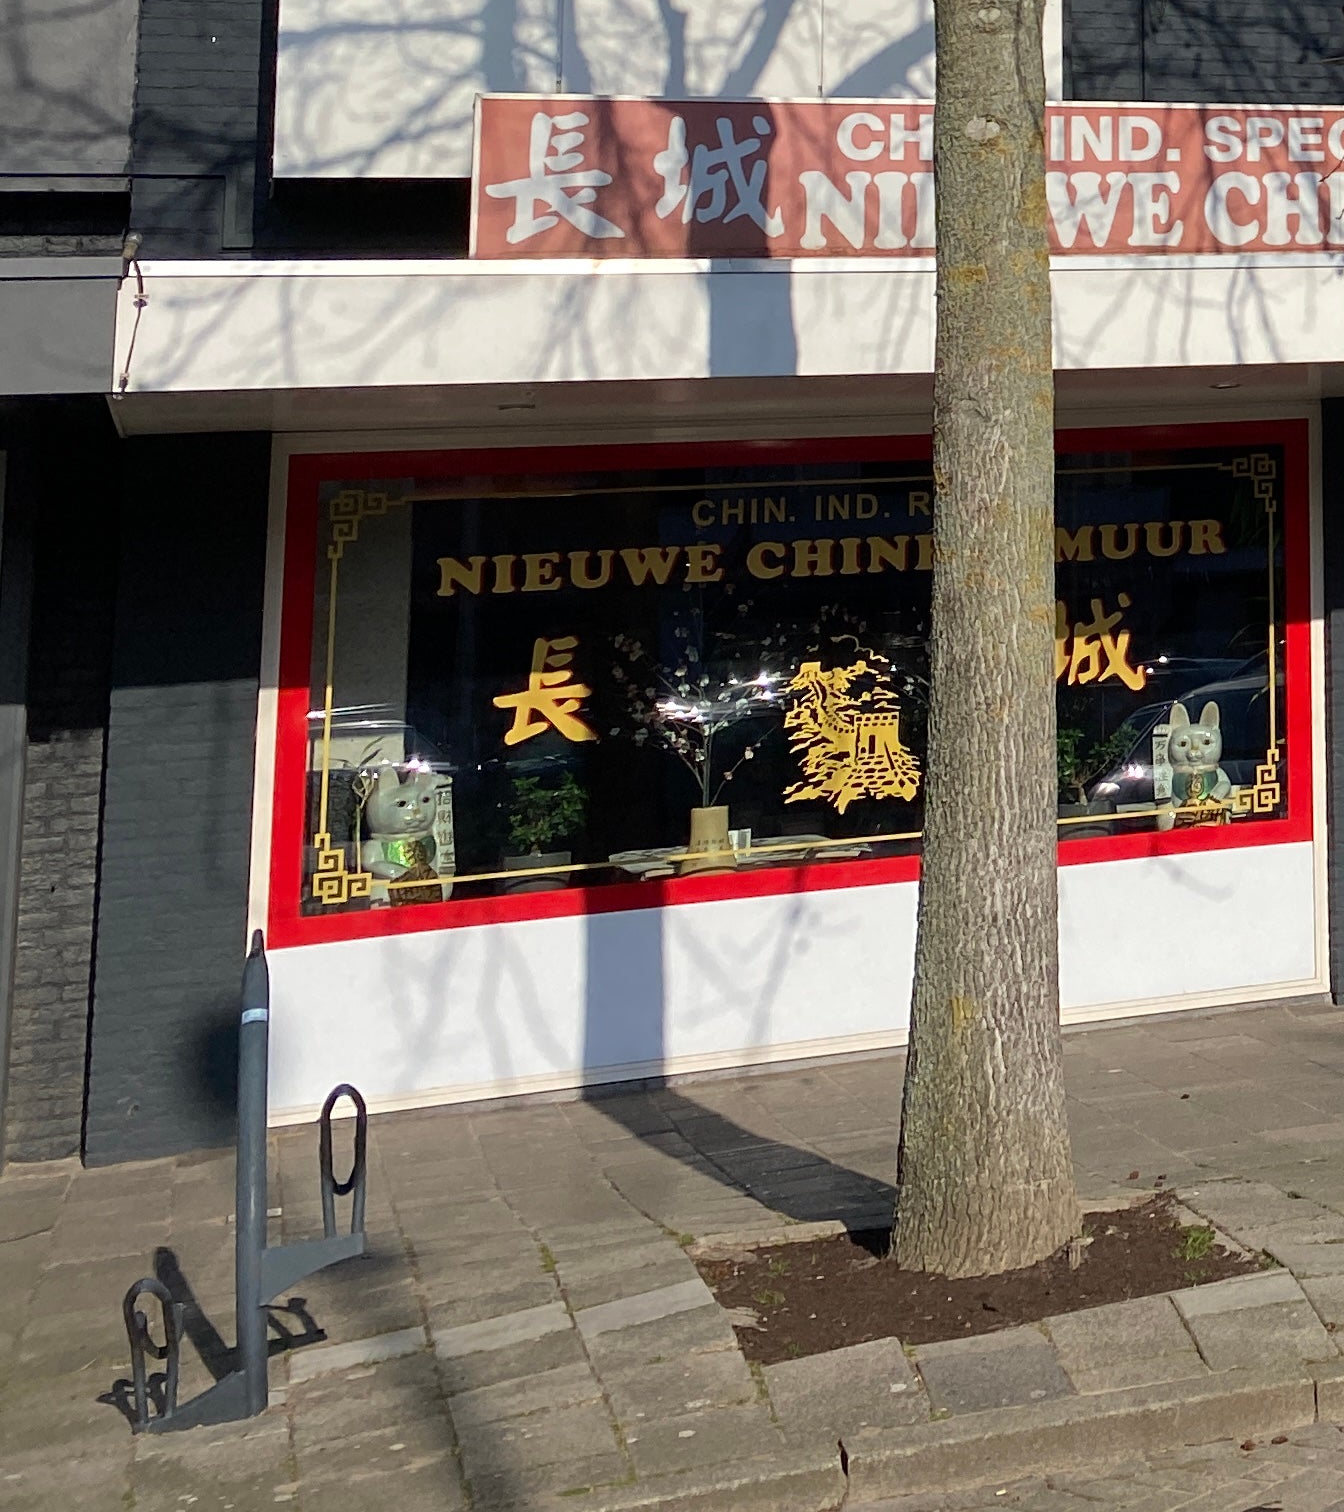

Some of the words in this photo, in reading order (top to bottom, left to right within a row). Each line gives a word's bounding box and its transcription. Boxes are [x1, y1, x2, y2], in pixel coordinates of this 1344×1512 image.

[1050, 115, 1181, 162] IND.
[799, 170, 1184, 249] NIWE
[691, 496, 796, 527] CHIN.
[815, 493, 890, 521] IND.
[436, 544, 725, 597] NIEUWE
[746, 534, 935, 580] CHIN
[1055, 519, 1226, 562] MUUR
